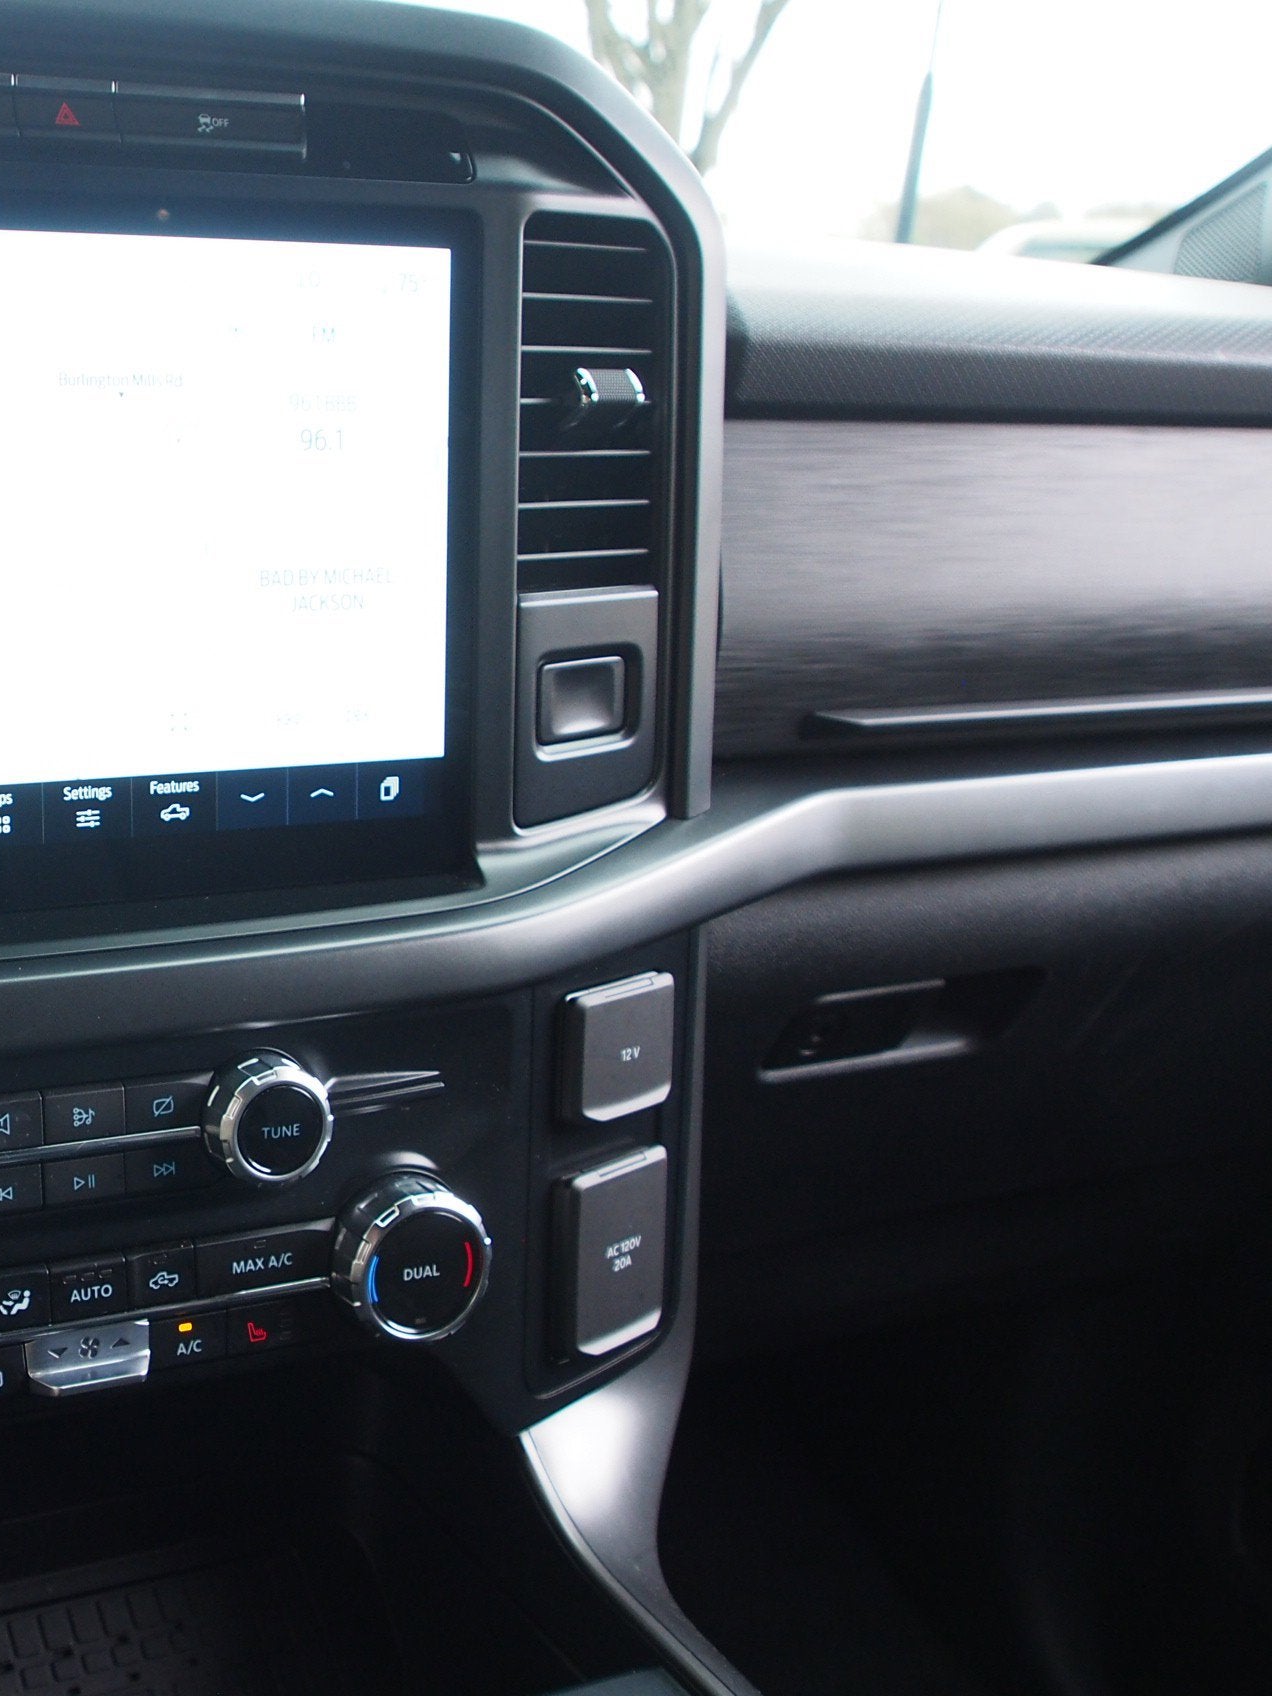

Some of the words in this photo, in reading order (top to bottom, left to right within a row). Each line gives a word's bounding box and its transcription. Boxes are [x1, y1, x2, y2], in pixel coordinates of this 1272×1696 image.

[212, 117, 229, 127] OFF
[58, 371, 129, 390] Burlington
[299, 427, 344, 451] 96.1
[259, 568, 294, 587] BAD
[298, 568, 319, 586] BY
[323, 567, 394, 585] MICHAEL
[291, 593, 365, 613] JACKSON
[63, 784, 112, 801] Settings
[149, 779, 199, 796] Features
[262, 1123, 300, 1139] TUNE
[607, 1244, 620, 1259] AC
[620, 1235, 642, 1253] 120V
[232, 1258, 265, 1275] MAX
[268, 1252, 293, 1269] A/C
[613, 1254, 632, 1272] 20A
[403, 1264, 440, 1282] DUAL
[70, 1284, 113, 1302] AUTO
[177, 1340, 202, 1355] A/C
